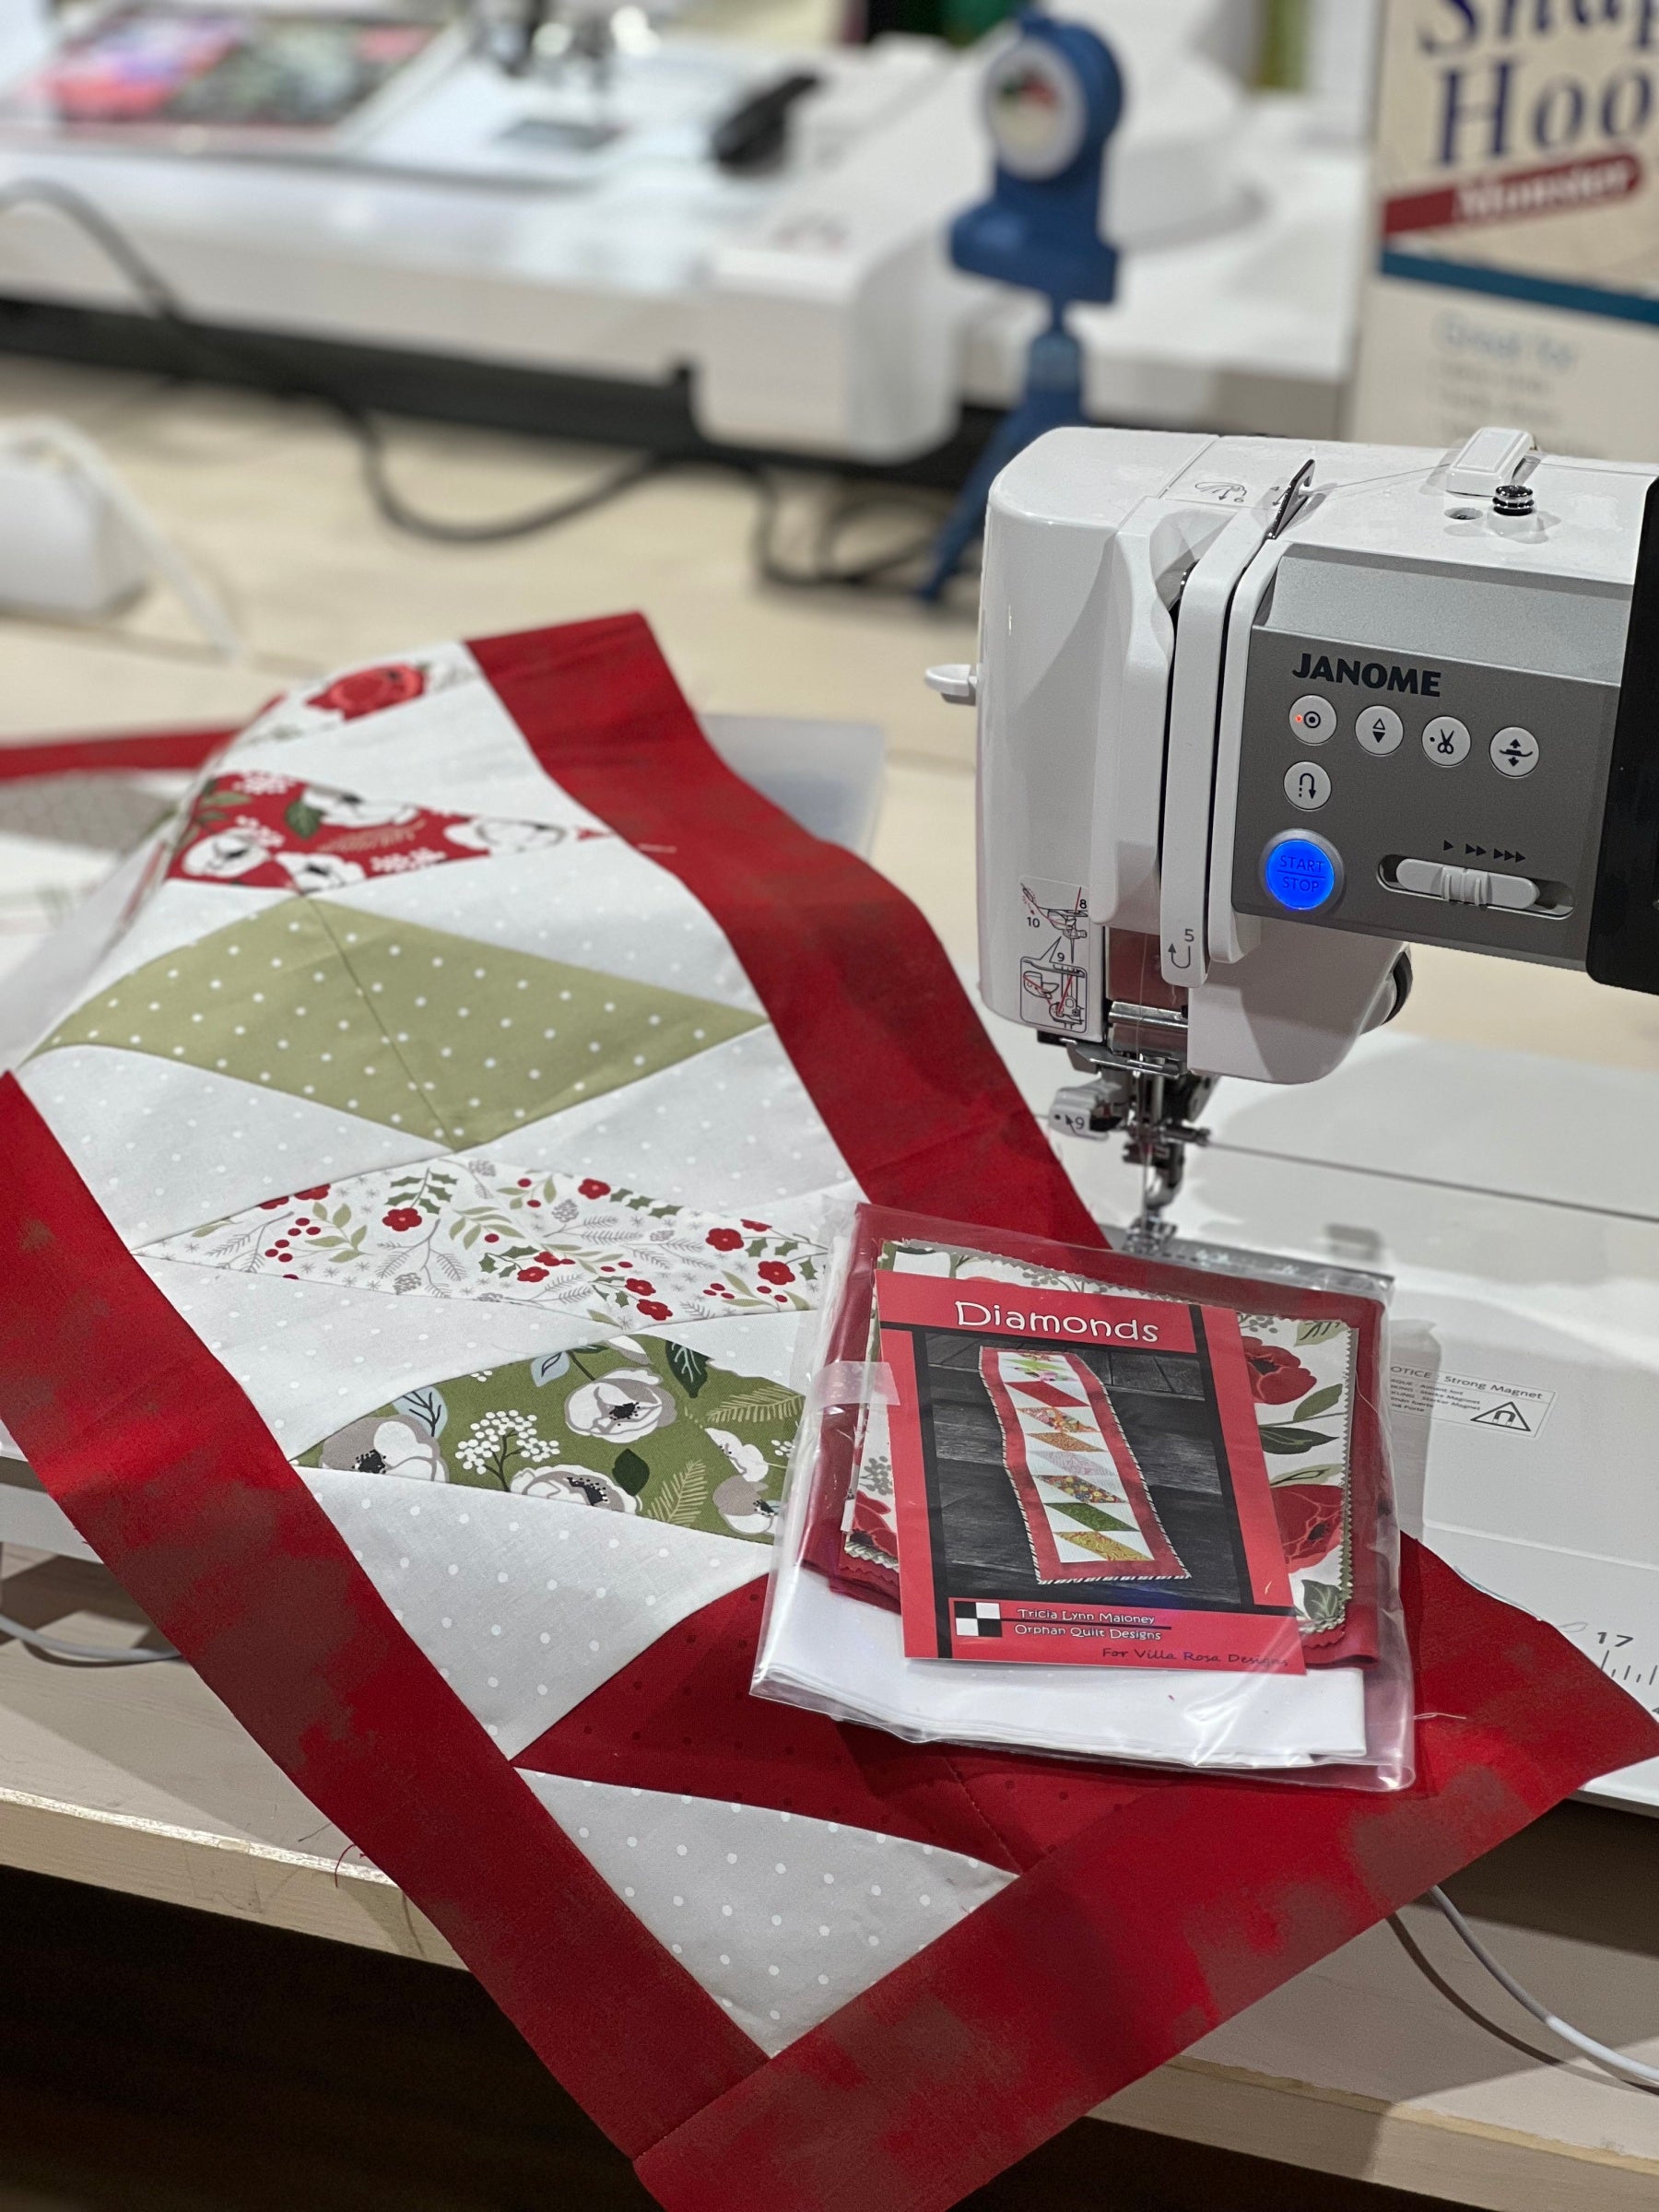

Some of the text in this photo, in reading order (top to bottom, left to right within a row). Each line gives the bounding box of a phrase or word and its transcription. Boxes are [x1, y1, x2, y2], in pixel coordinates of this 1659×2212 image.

[1291, 653, 1441, 698] JANOME
[1279, 854, 1324, 873] START
[1282, 876, 1319, 892] STOP
[1079, 899, 1088, 910] 8
[1027, 916, 1041, 928] 10
[1183, 928, 1195, 942] 5
[1056, 952, 1065, 962] 9
[955, 1300, 1159, 1343] Diamonds
[1390, 1366, 1543, 1400] OTICE Strong Magnet
[1018, 1608, 1155, 1625] Tricia Lynn Maloney
[1015, 1624, 1161, 1641] Orphan Quilt Designs
[1596, 1631, 1634, 1647] 17
[1102, 1647, 1289, 1668] For Villa Rosa Designs
